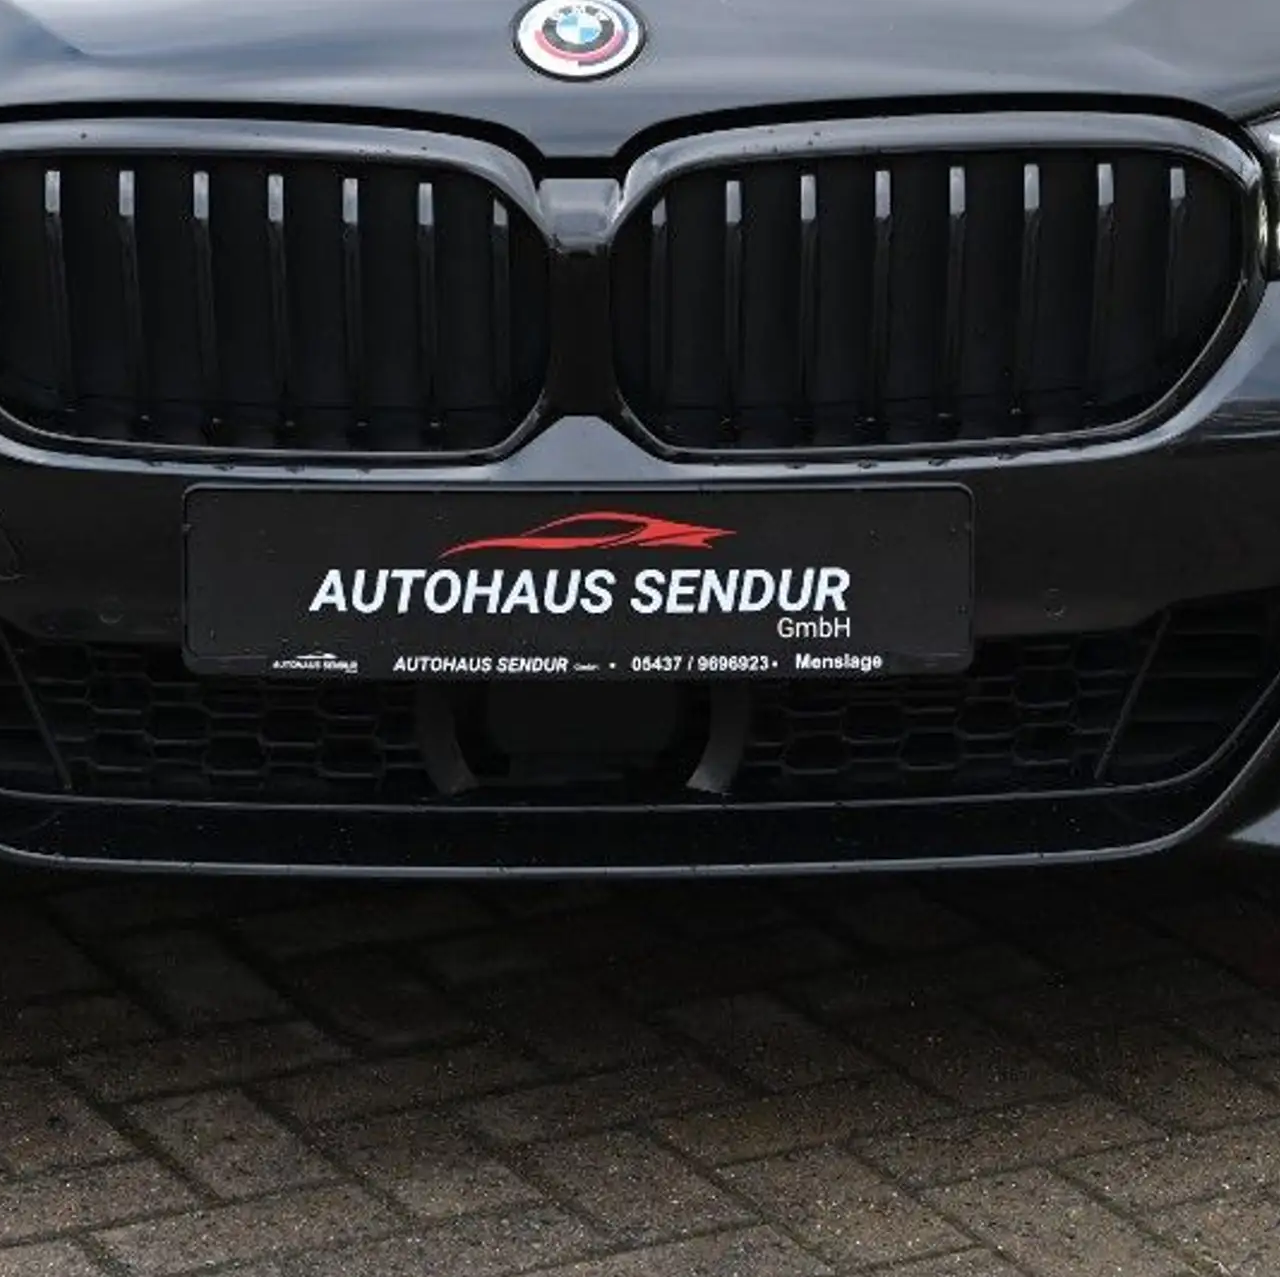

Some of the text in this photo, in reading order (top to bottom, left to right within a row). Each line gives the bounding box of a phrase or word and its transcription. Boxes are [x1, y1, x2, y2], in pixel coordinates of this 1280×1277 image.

[308, 566, 851, 615] AUTOHAUS SENDUR
[776, 616, 851, 639] GmbH
[392, 655, 493, 673] AUTOHAUS
[495, 655, 570, 673] SENDUR
[631, 655, 683, 672] 05437
[795, 652, 884, 673] Menslage
